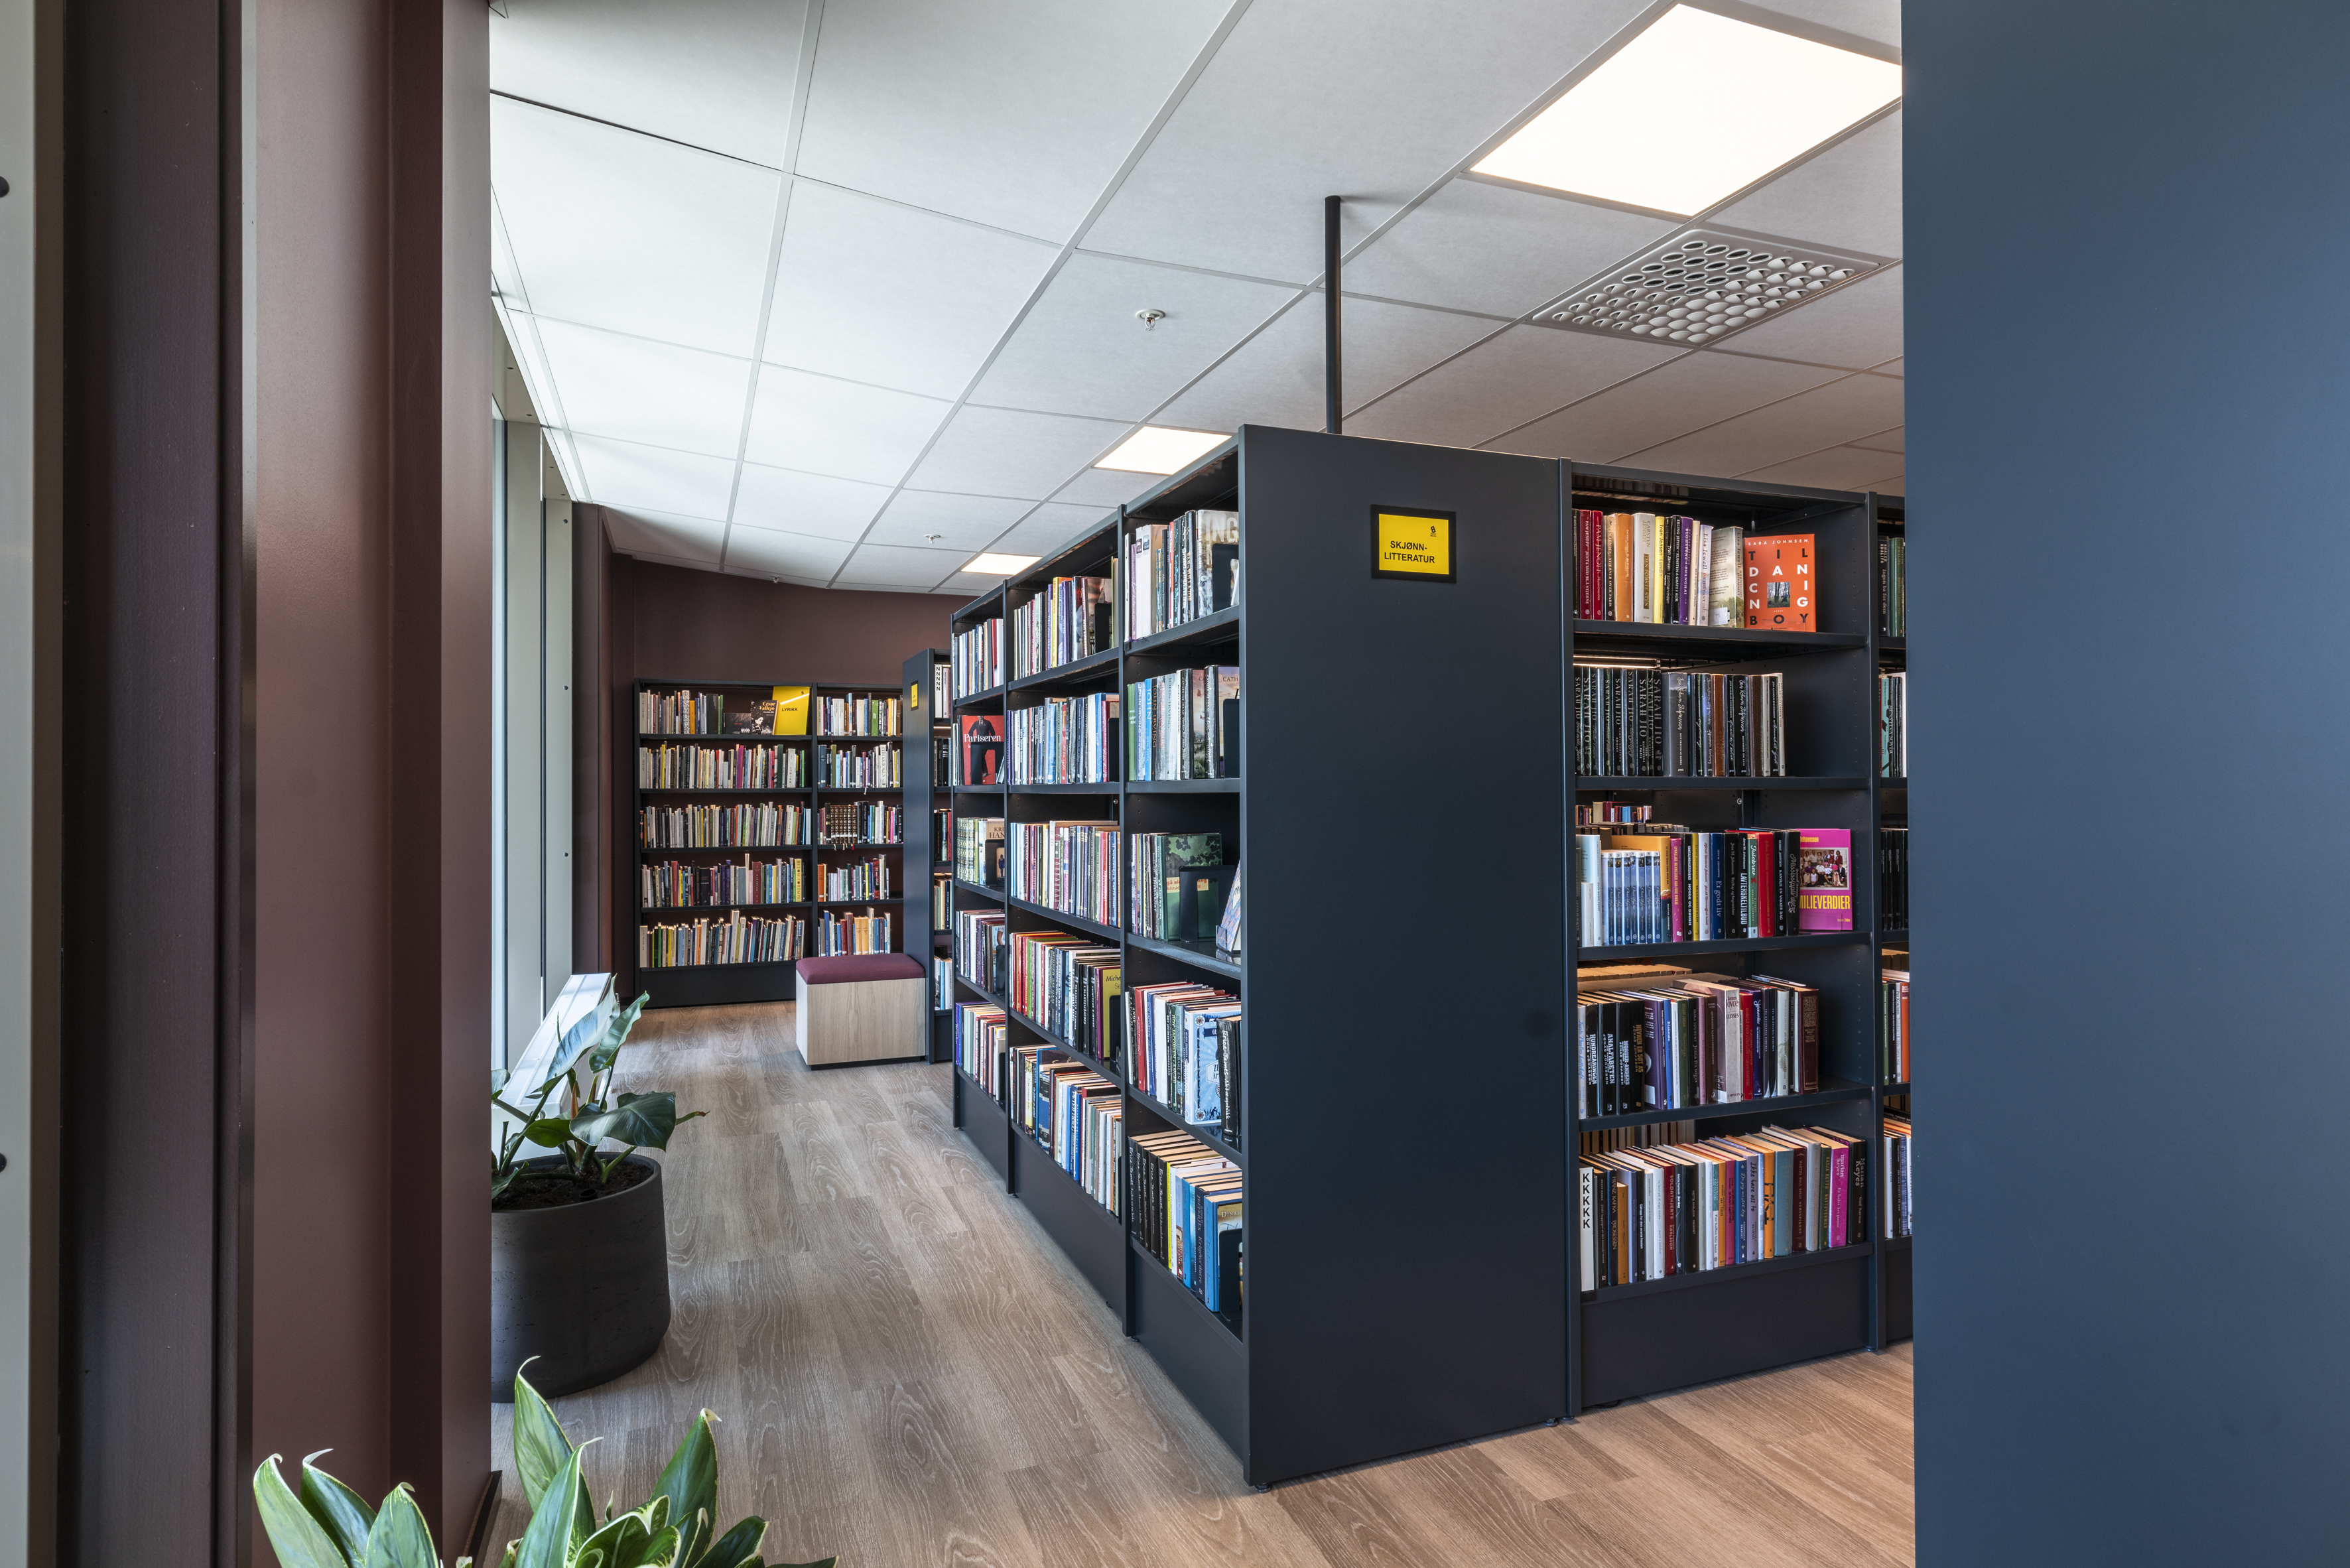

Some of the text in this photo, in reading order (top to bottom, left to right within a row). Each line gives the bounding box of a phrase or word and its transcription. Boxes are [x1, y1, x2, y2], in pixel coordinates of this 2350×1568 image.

[1390, 541, 1427, 551] SKJØNN-
[1384, 552, 1435, 563] LITTERATUR
[964, 734, 1001, 742] Pariseren
[1726, 999, 1739, 1010] Joyce
